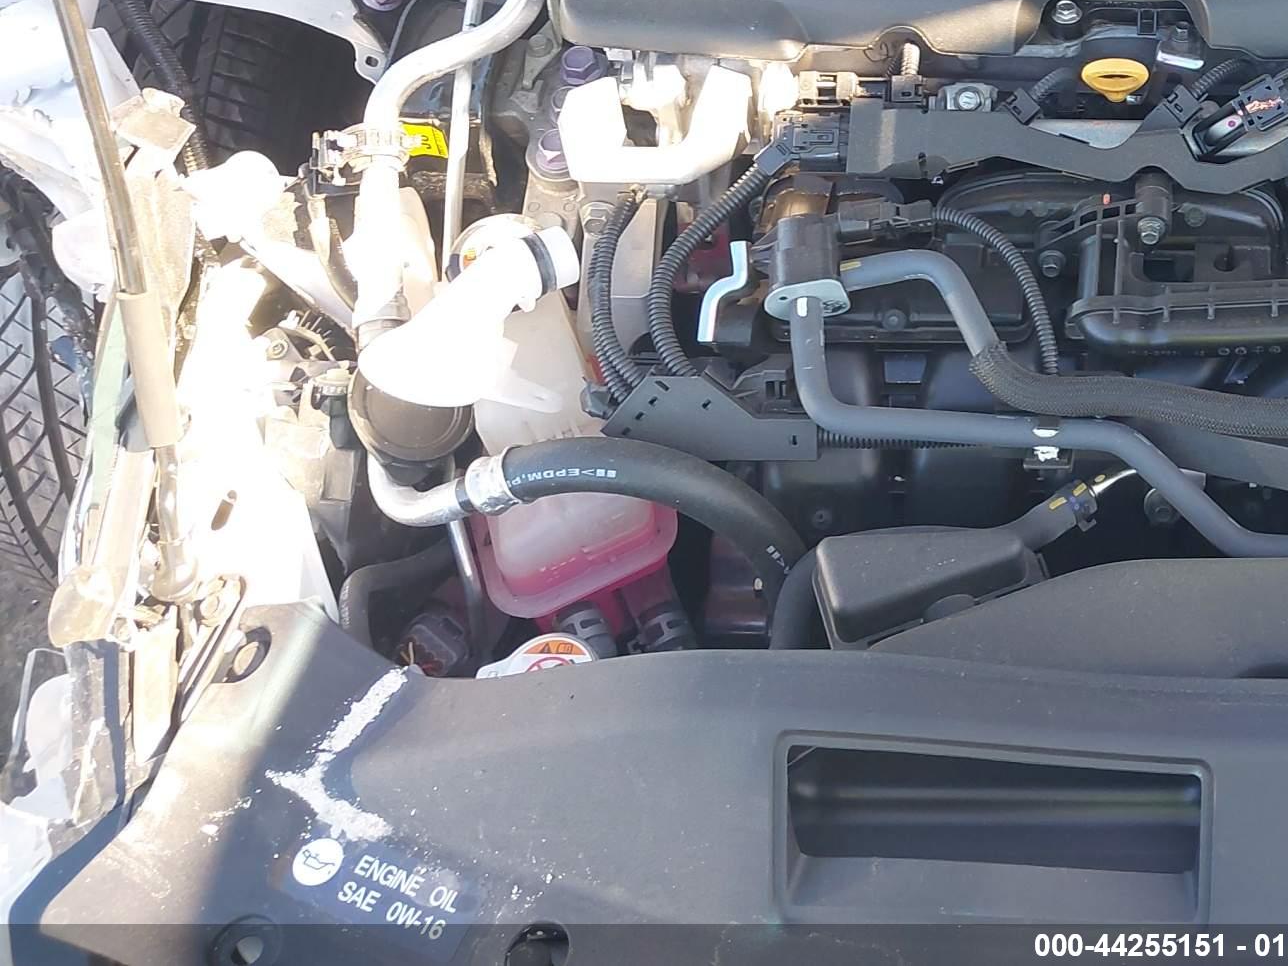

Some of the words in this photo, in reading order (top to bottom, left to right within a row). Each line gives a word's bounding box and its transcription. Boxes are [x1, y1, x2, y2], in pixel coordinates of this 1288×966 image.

[337, 881, 382, 913] SAE
[385, 901, 446, 940] 0W-16
[354, 854, 426, 898] ENGINE
[429, 886, 459, 914] OIL
